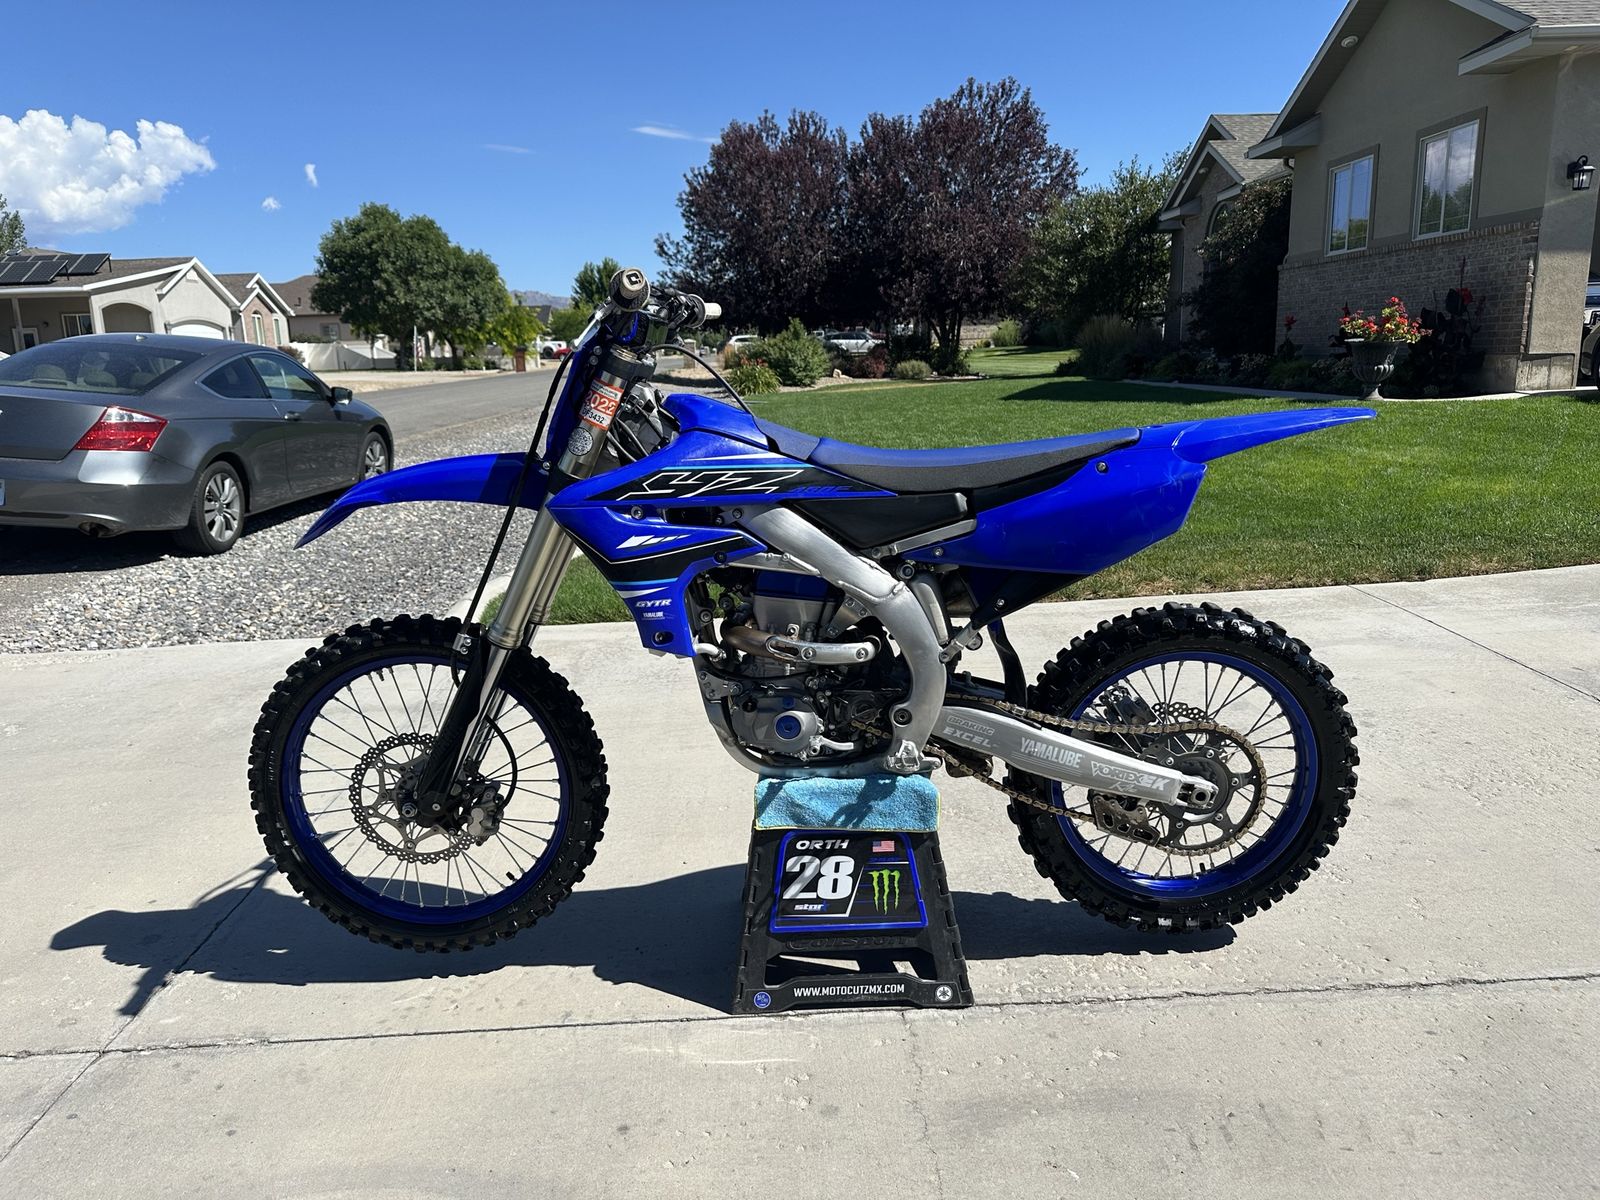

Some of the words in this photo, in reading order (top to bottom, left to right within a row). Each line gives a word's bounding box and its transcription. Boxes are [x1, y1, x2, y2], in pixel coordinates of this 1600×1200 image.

[635, 598, 672, 607] GYTR
[947, 715, 996, 736] BRAKING
[943, 726, 992, 748] EXCEL
[1021, 736, 1083, 769] YAMALUBE
[795, 839, 850, 850] ORTH
[782, 855, 855, 899] 28
[793, 984, 905, 997] WWW.MOTOCUTZMX.COM
